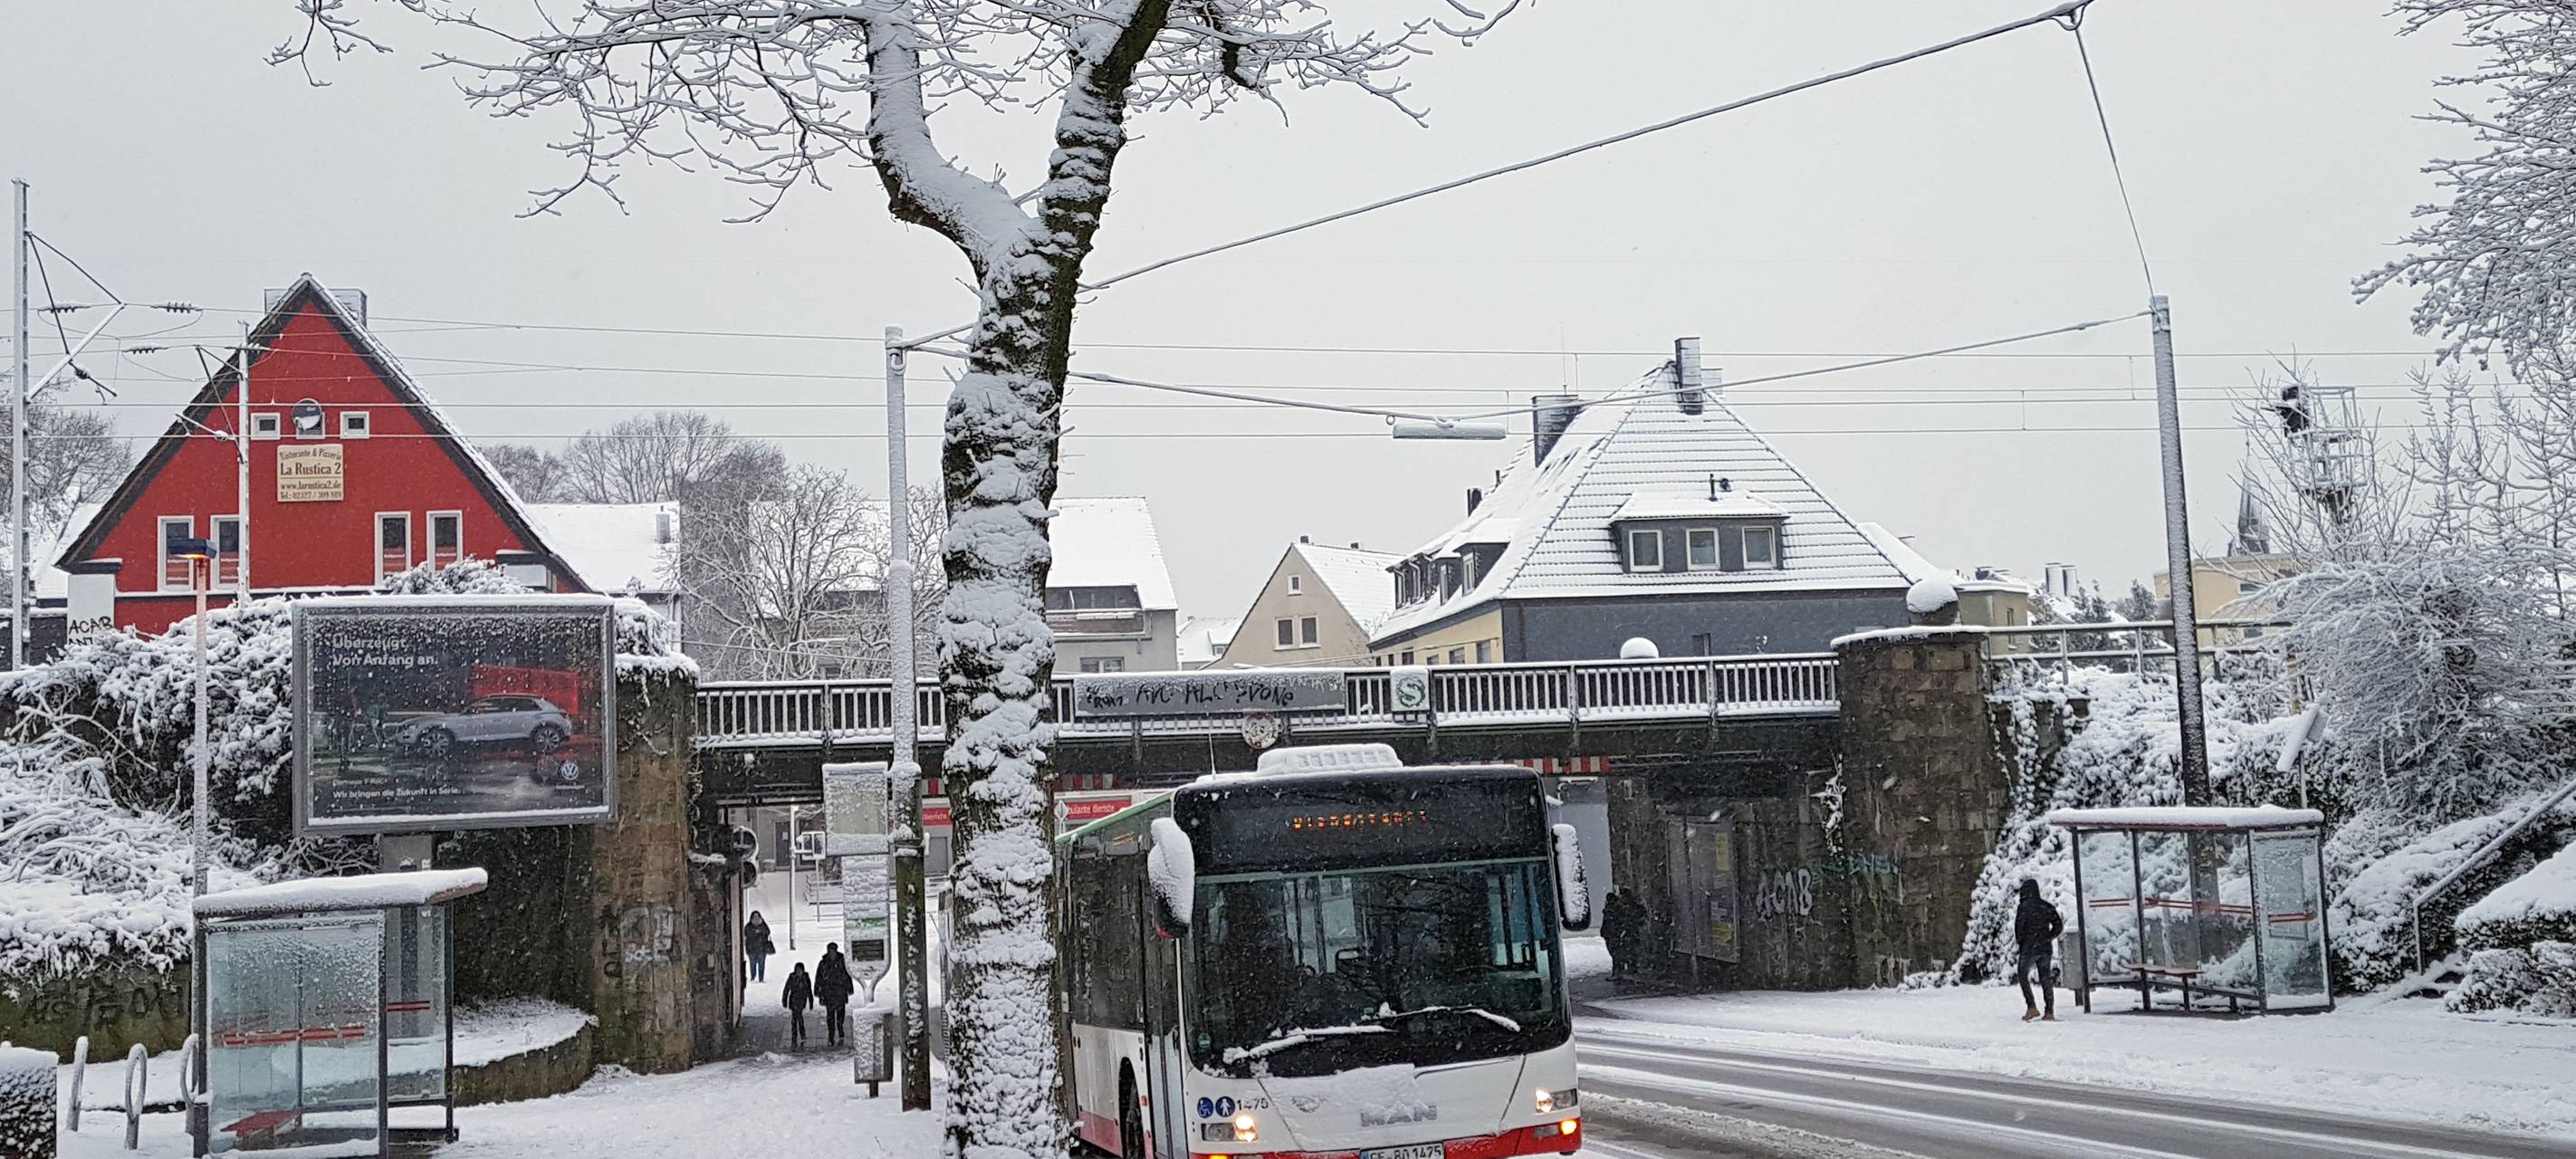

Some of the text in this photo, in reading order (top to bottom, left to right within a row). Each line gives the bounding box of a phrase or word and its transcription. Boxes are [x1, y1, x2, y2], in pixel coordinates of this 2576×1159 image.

[281, 463, 341, 475] La Rustica 2
[68, 616, 113, 635] ACAB
[332, 654, 361, 666] Von
[363, 652, 414, 668] Anfang
[332, 790, 348, 799] Wir
[350, 790, 381, 800] bringen
[397, 787, 428, 796] Zukunft
[429, 787, 437, 795] in
[1360, 1104, 1438, 1127] MAN
